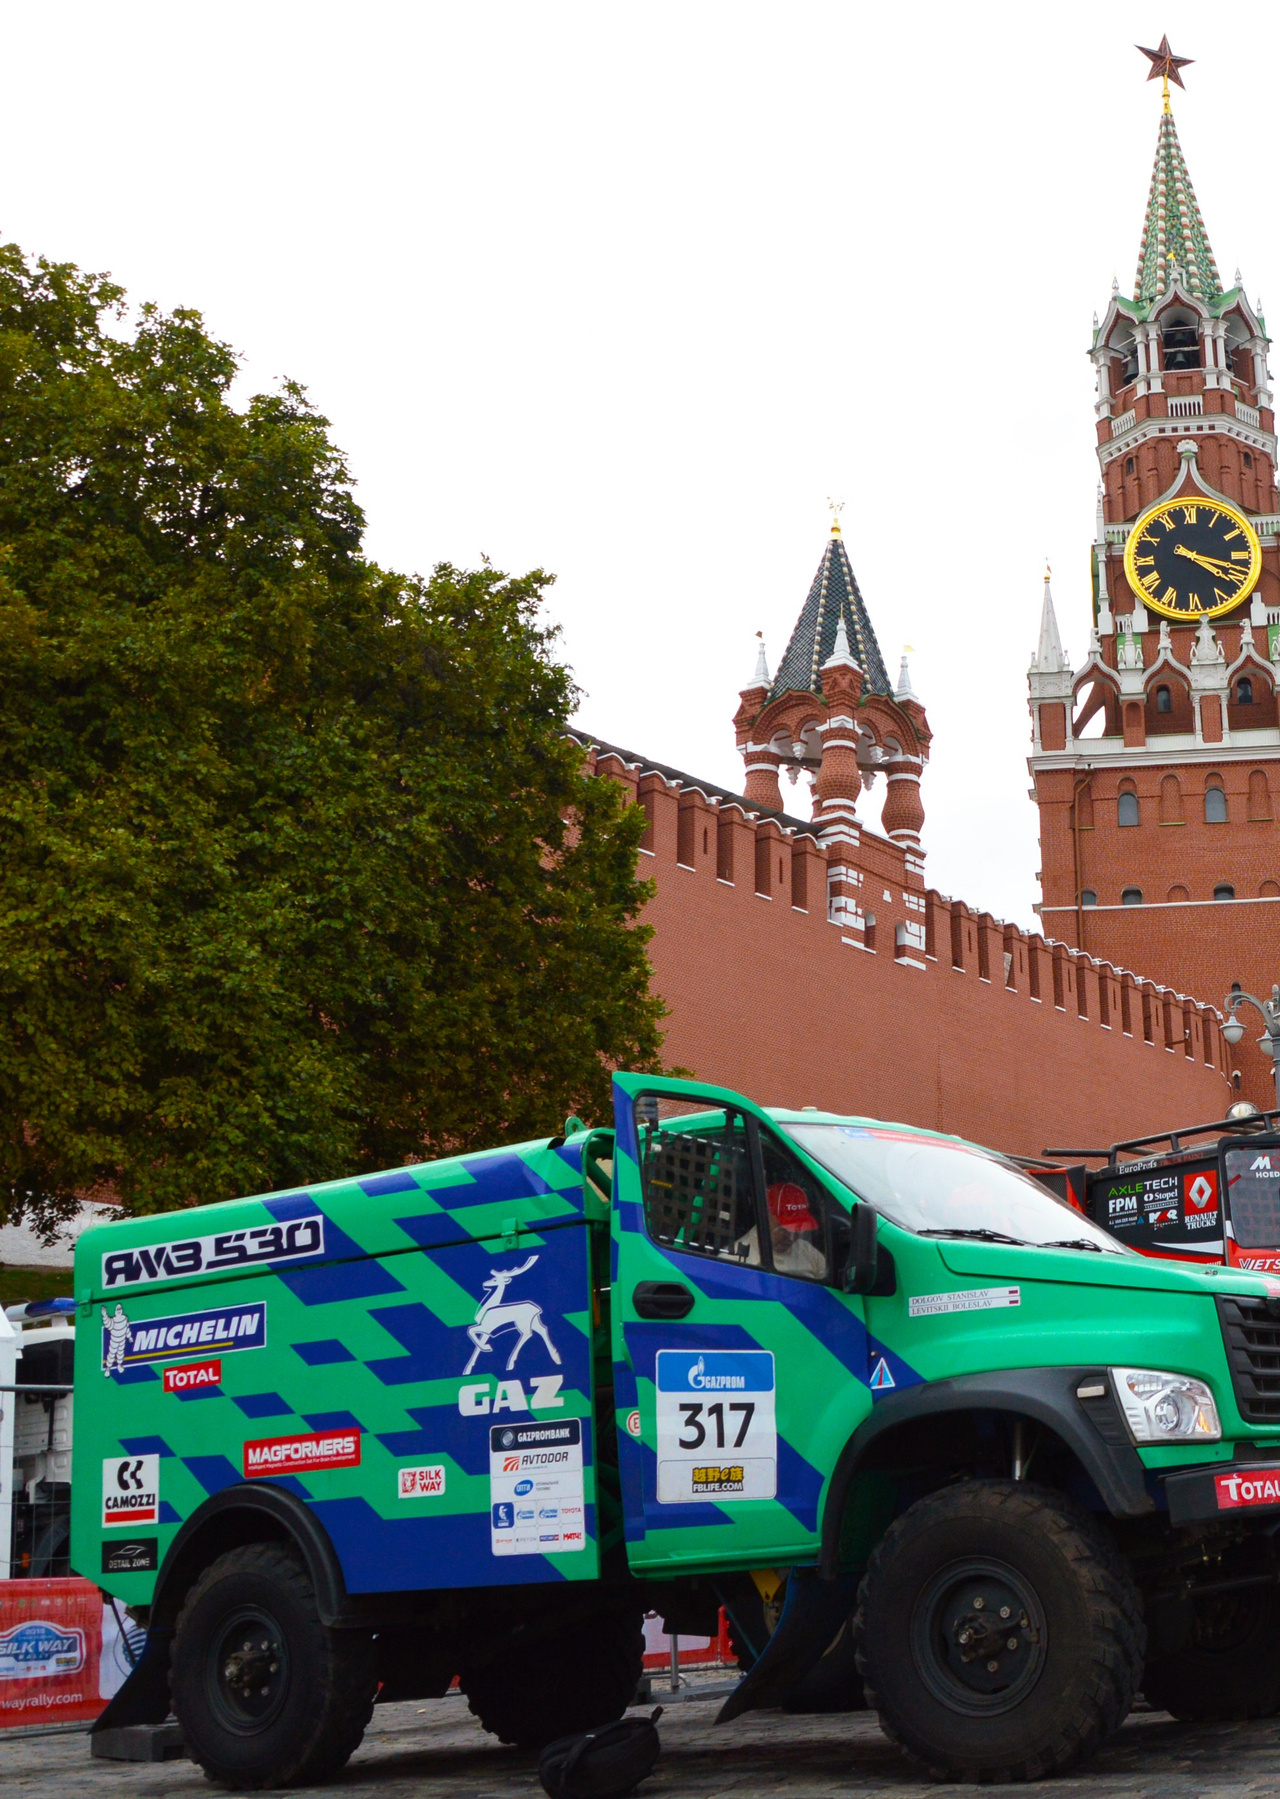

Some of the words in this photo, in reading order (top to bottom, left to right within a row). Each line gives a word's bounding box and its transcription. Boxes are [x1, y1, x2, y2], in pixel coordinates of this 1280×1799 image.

[1108, 1176, 1178, 1197] AXLETECH
[1155, 1189, 1178, 1200] Stopel
[1108, 1196, 1137, 1213] FPM
[1184, 1211, 1218, 1223] RENAULT
[1186, 1219, 1216, 1230] TRUCKS
[205, 1220, 321, 1270] 530
[912, 1295, 944, 1305] DOLGOV
[947, 1290, 989, 1301] STANISLAV
[912, 1304, 949, 1315] LEVITSKII
[952, 1300, 993, 1310] BOLESLAV
[133, 1313, 260, 1352] MICHELIN
[166, 1368, 219, 1388] TOTAL
[705, 1376, 745, 1389] GAZPROM
[458, 1374, 564, 1417] GAZ
[679, 1403, 755, 1450] 317
[518, 1428, 570, 1443] GAZPROMBANK
[248, 1436, 355, 1464] MAGFORMERS
[521, 1452, 569, 1466] AVTODOR
[419, 1469, 442, 1480] SILK
[419, 1481, 442, 1492] WAY
[693, 1482, 743, 1492] FBLIFE.COM
[105, 1493, 156, 1510] CAMOZZI
[108, 1558, 131, 1568] DETAIL
[132, 1557, 150, 1567] ZONE
[0, 1641, 36, 1654] SILK
[38, 1639, 73, 1652] WAY
